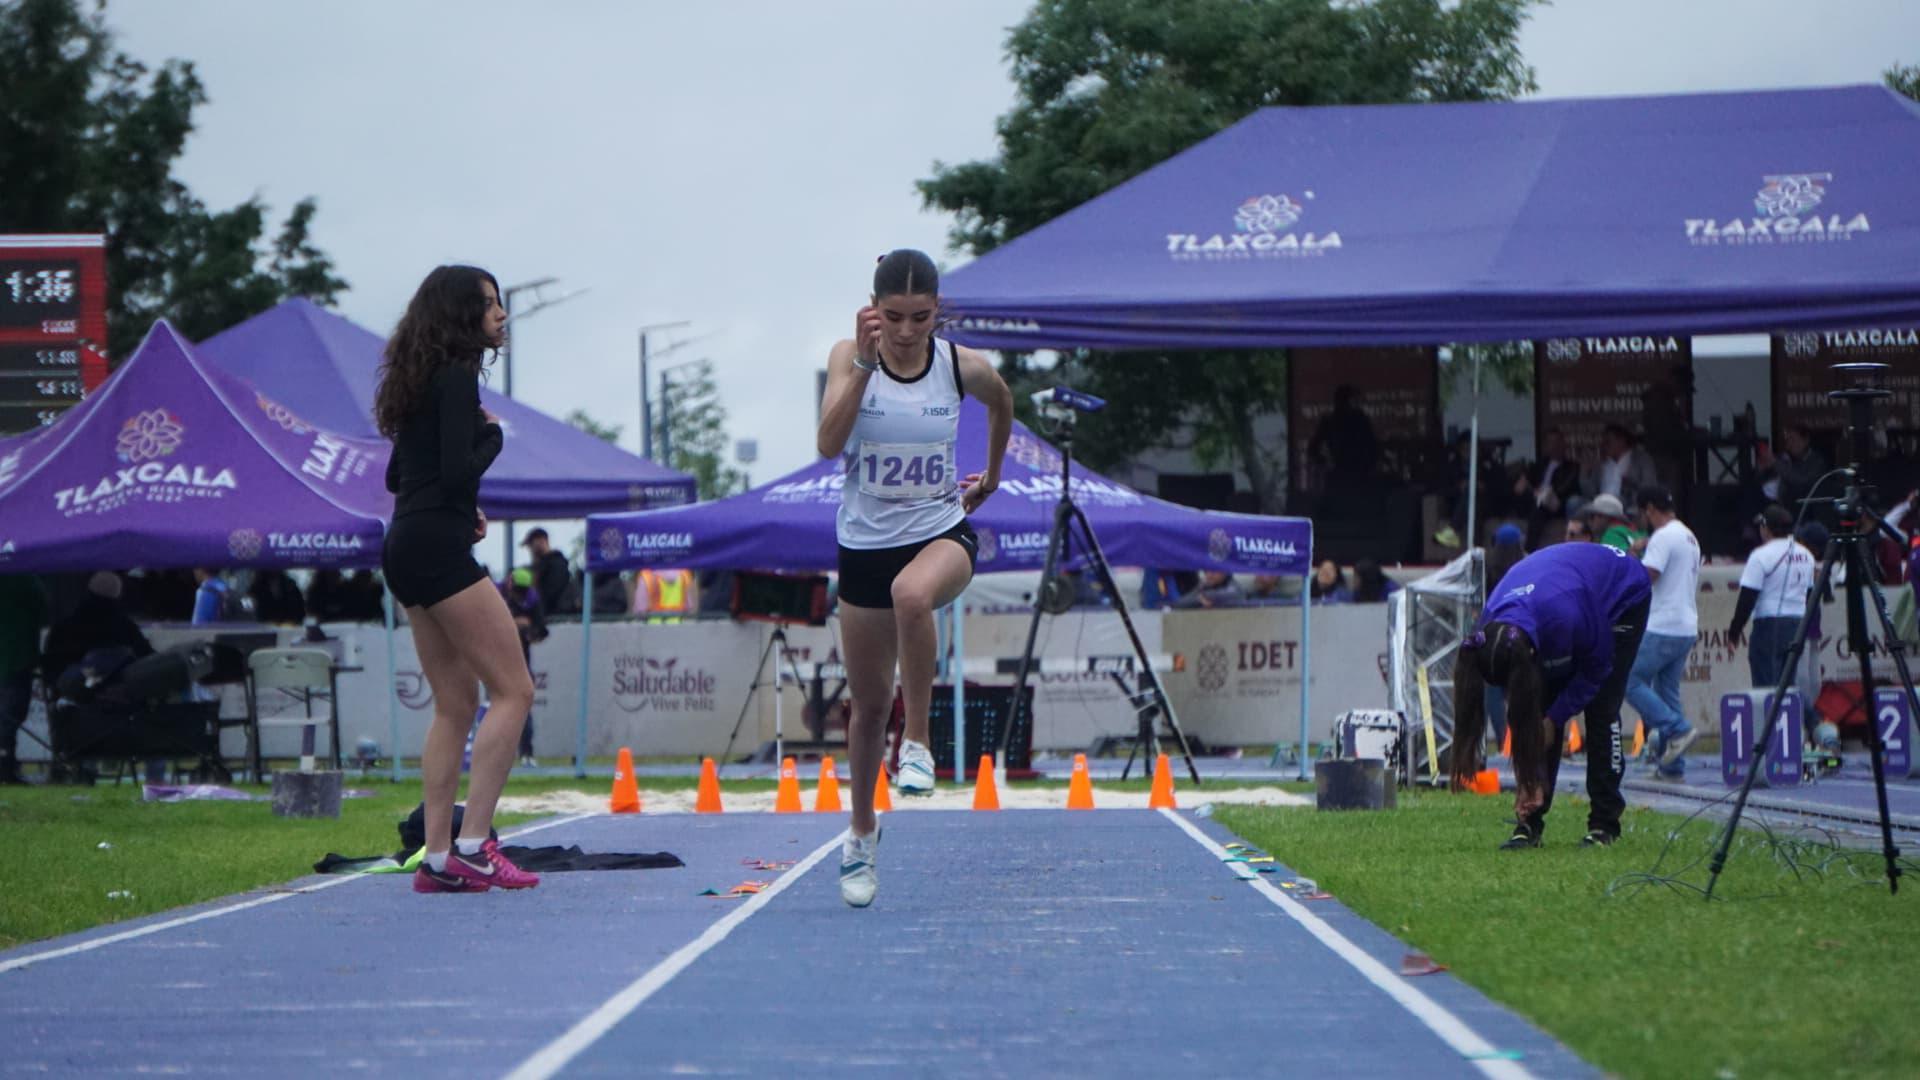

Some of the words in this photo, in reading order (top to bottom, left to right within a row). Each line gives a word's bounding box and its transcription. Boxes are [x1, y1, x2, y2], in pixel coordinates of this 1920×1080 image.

[1685, 212, 1870, 237] TLAXCALA
[1166, 231, 1342, 251] TLAXCALA
[1585, 336, 1679, 354] TLAXCALA
[1824, 328, 1920, 348] TLAXCALA
[863, 453, 945, 486] 1246
[54, 462, 236, 511] TLAXCALA
[267, 532, 362, 549] TLAXCALA
[626, 532, 692, 549] TLAXCALA
[1233, 535, 1297, 556] TLAXCALA
[1237, 641, 1299, 670] IDET
[612, 667, 717, 696] Saludable
[1730, 711, 1743, 760] 1
[1775, 710, 1789, 758] 1
[1878, 705, 1902, 749] 2
